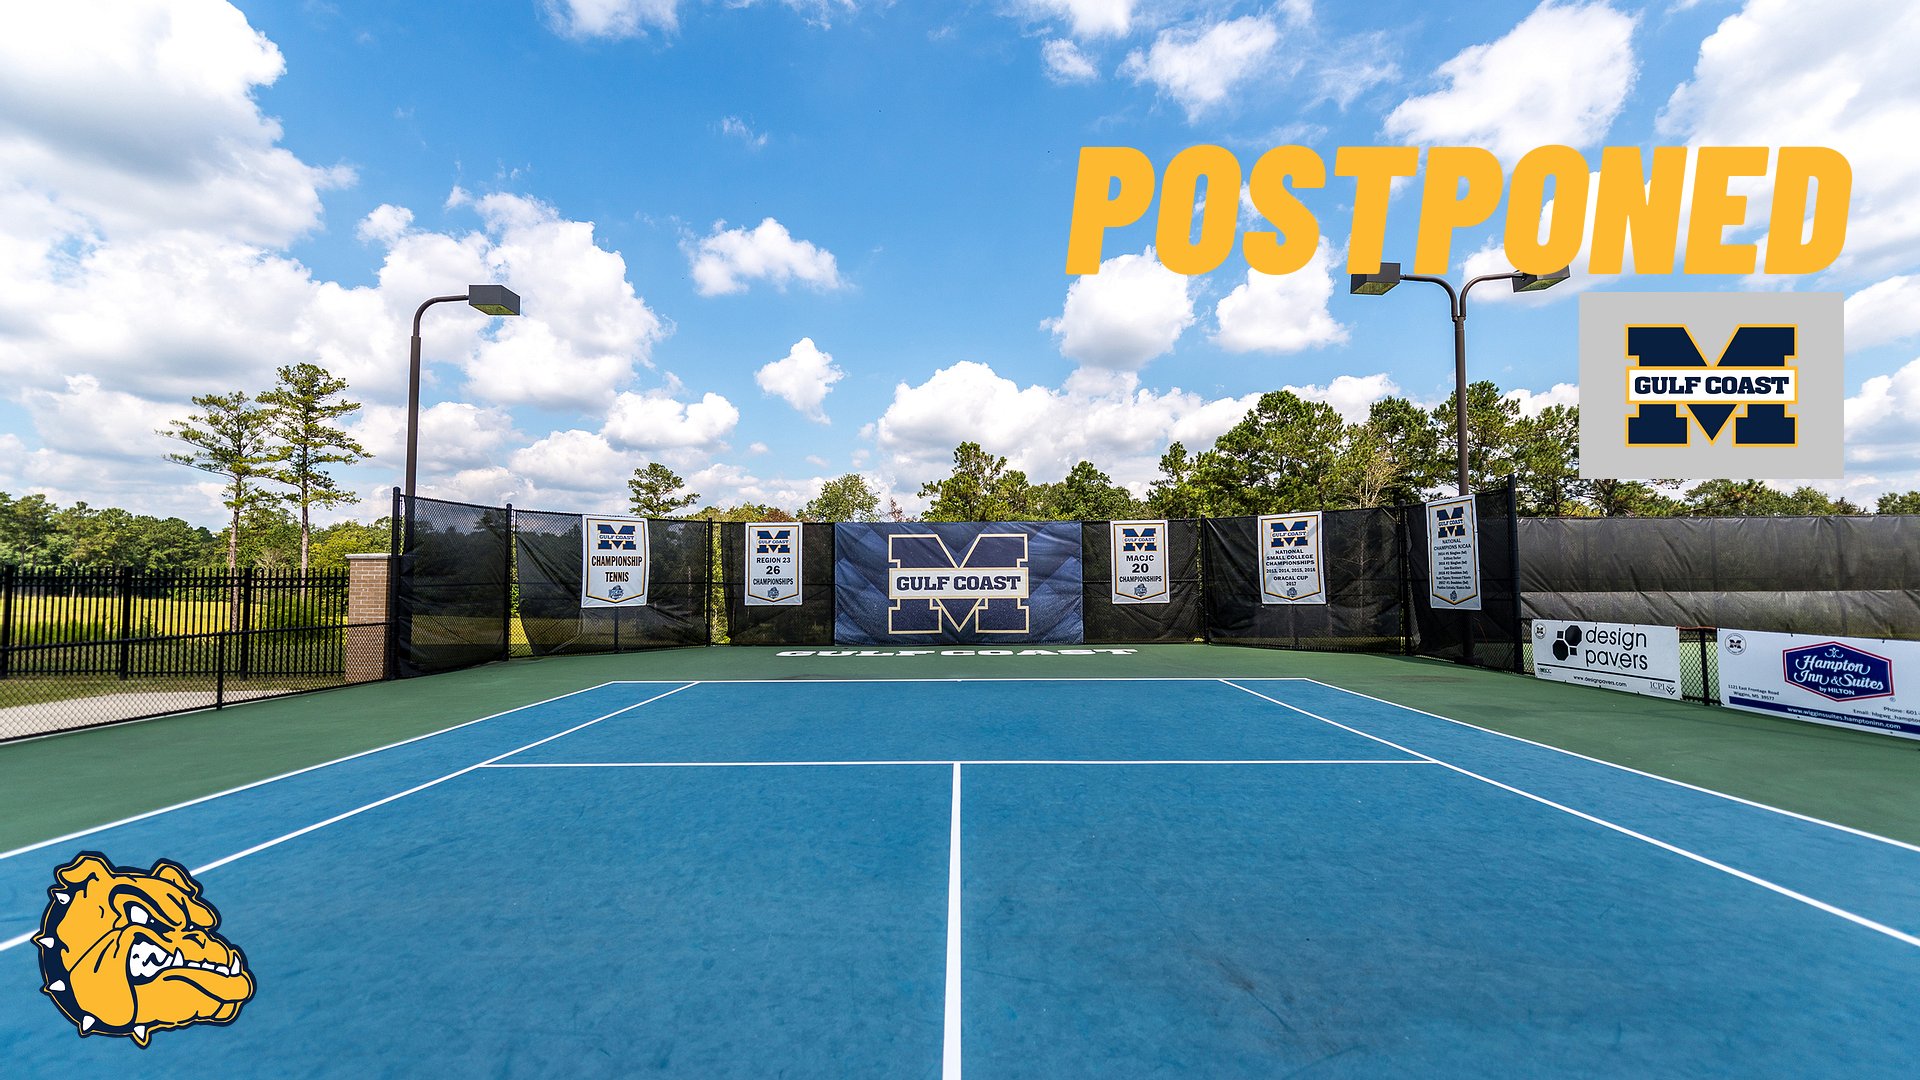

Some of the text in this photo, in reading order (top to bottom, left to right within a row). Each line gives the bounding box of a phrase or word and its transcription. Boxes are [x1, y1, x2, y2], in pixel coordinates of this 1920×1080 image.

[591, 556, 643, 567] CHAMPIONSHIP
[766, 566, 780, 575] 26
[1132, 563, 1149, 573] 20
[605, 571, 630, 582] TENNIS
[896, 574, 1021, 591] GULF COAST
[1585, 626, 1647, 651] design
[940, 649, 1138, 657] COAST
[1585, 649, 1648, 671] pavers
[1795, 655, 1871, 675] Hampton
[1650, 681, 1665, 690] ICPI
[1793, 670, 1830, 685] Inn
[1837, 673, 1884, 690] Suites
[1828, 687, 1855, 695] HILTON
[1787, 707, 1901, 730] www.wigginssuites.hamptoninn.com
